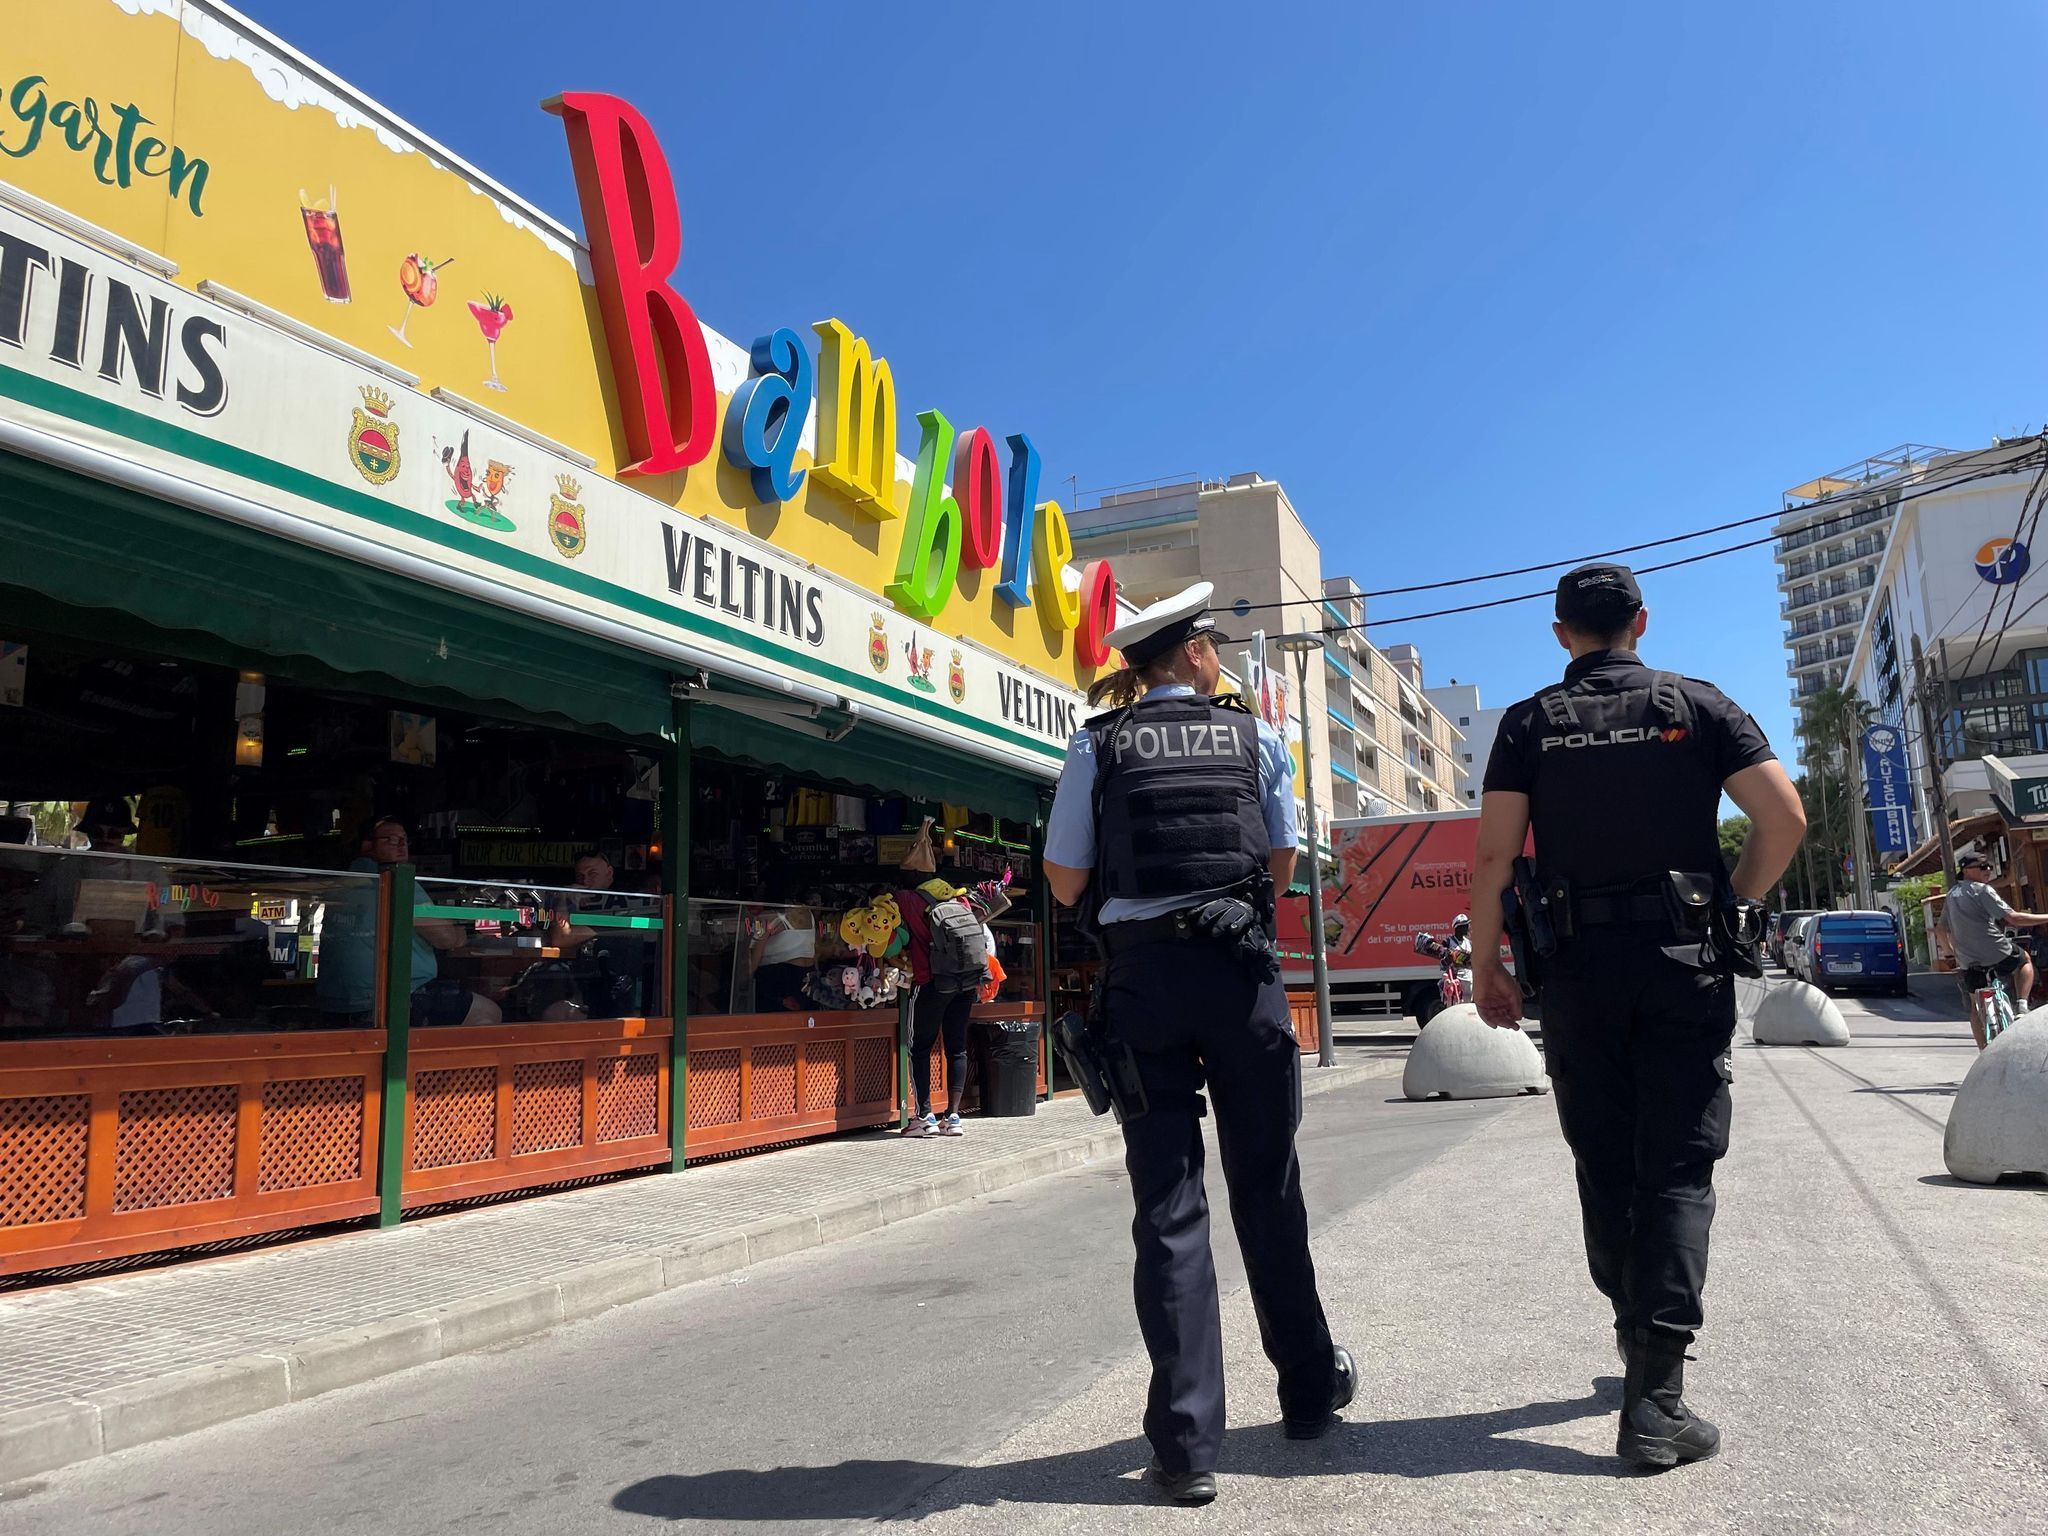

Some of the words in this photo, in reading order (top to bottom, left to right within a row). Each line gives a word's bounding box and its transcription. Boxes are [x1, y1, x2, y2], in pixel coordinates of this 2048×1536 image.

[0, 76, 210, 218] garten
[541, 91, 1117, 668] Bamboleo
[661, 521, 825, 647] VELTINS
[997, 671, 1078, 739] VELTINS
[1115, 725, 1241, 764] POLIZEI
[1541, 726, 1664, 751] POLICIA
[1411, 869, 1473, 889] Asiáti
[261, 907, 284, 918] ATM
[1384, 935, 1412, 945] origen
